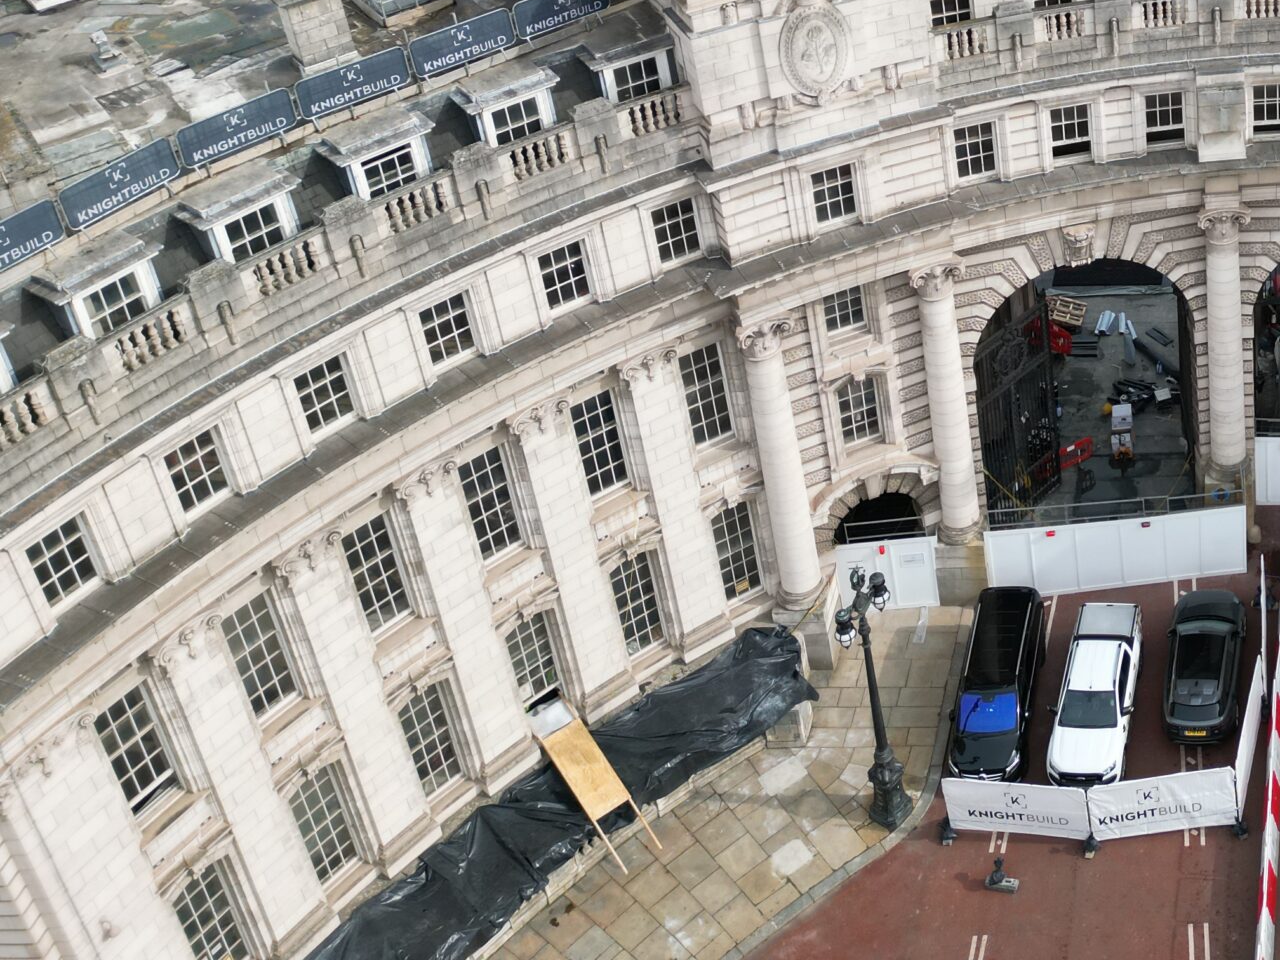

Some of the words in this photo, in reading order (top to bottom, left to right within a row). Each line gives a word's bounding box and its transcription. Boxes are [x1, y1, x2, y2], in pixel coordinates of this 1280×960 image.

[526, 0, 602, 34] KNIGHTBUILD
[423, 35, 507, 72] KNIGHTBUILD
[310, 74, 401, 114] KNIGHTBUILD
[193, 117, 287, 162] KNIGHTBUILD
[77, 168, 170, 223] KNIGHTBUILD
[968, 809, 1069, 825] KNIGHTBUILD
[1098, 802, 1203, 826] KNIGHTBUILD
